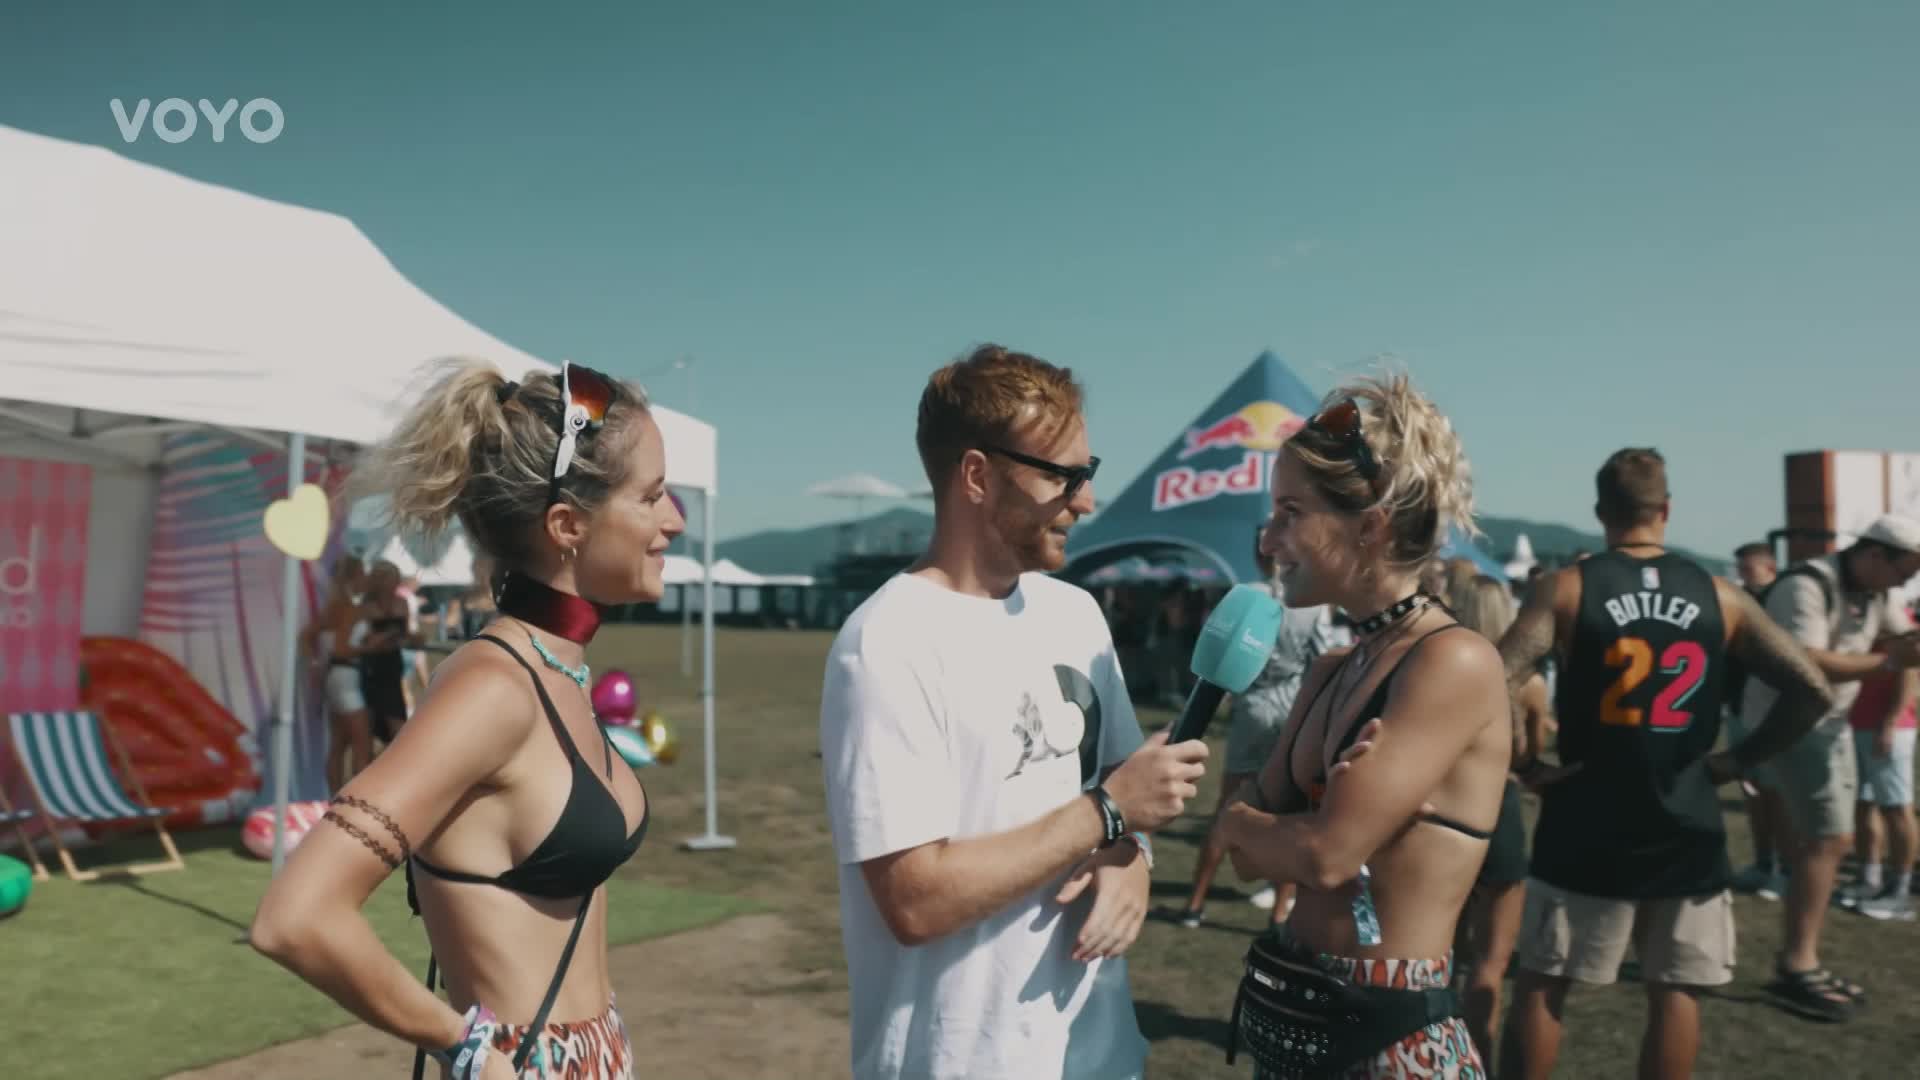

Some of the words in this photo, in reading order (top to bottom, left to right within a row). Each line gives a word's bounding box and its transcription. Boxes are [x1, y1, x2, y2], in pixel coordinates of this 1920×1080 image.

[1153, 452, 1263, 510] Red
[1604, 591, 1701, 630] BUTLER
[1602, 636, 1708, 732] 22
